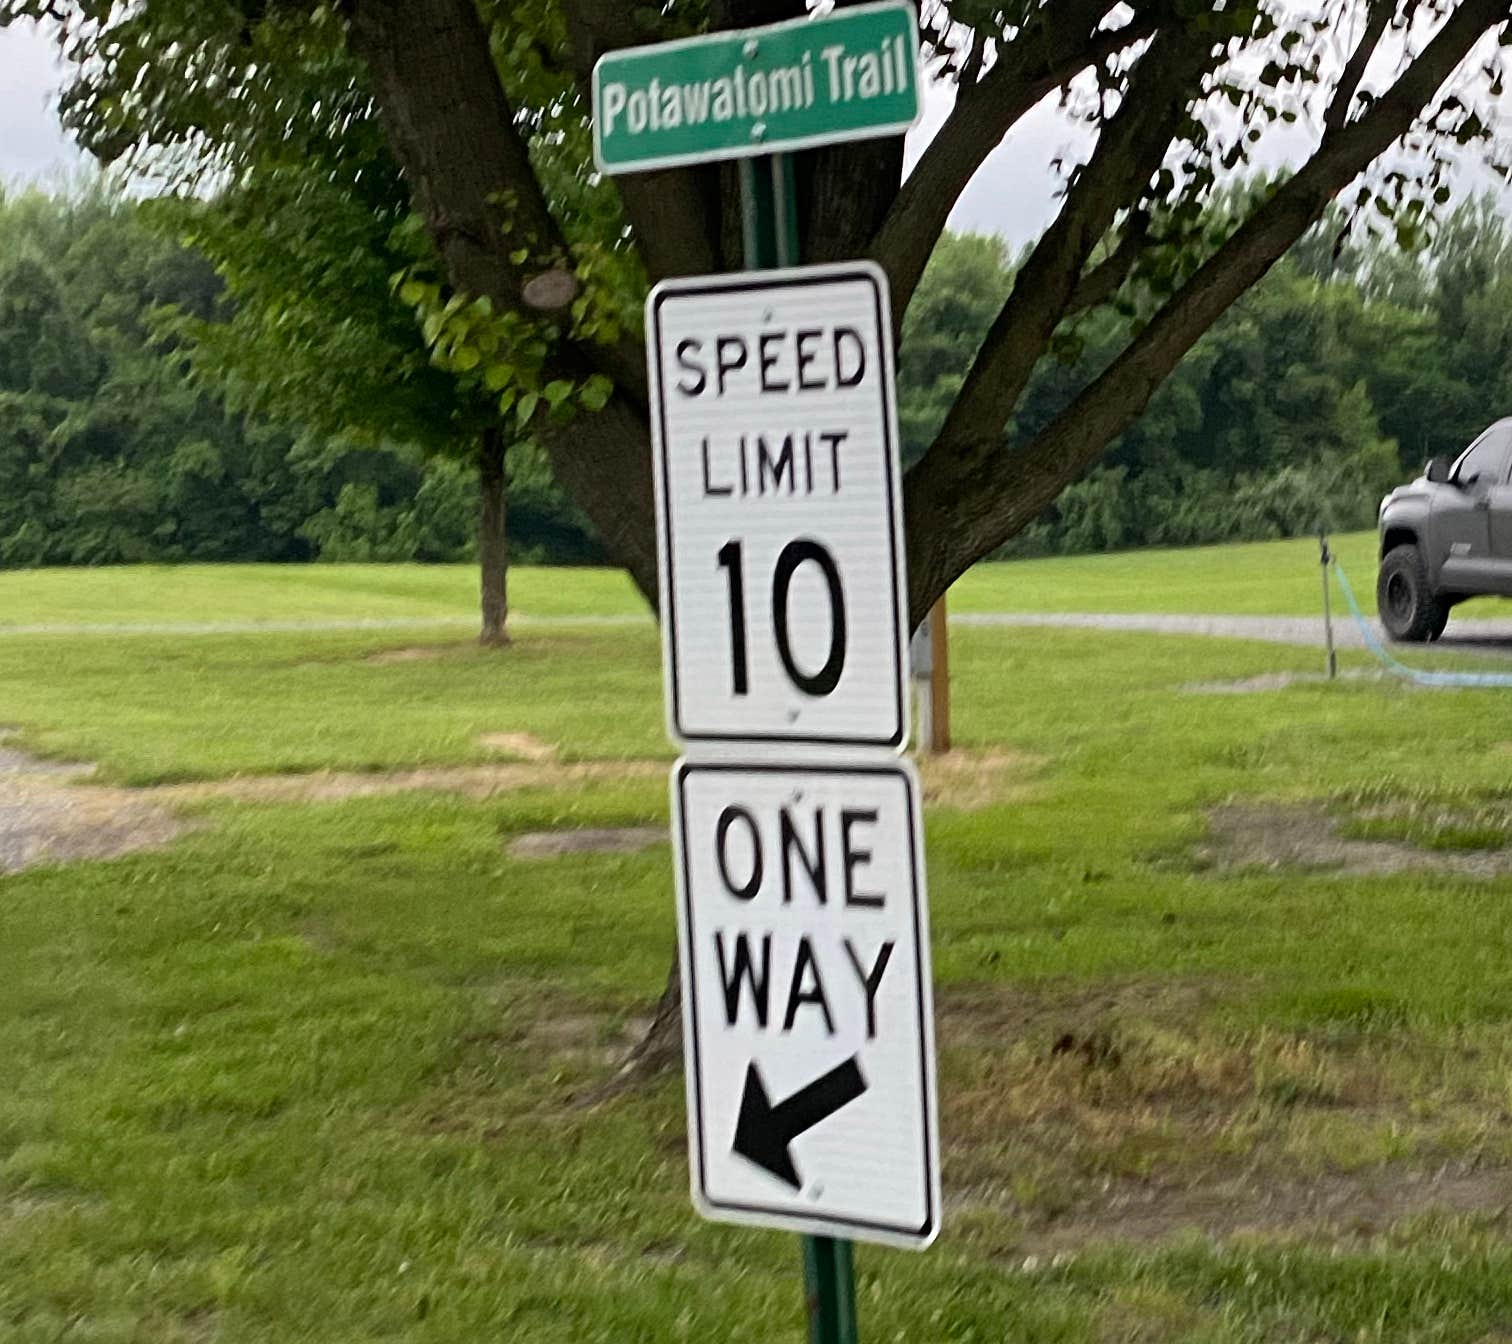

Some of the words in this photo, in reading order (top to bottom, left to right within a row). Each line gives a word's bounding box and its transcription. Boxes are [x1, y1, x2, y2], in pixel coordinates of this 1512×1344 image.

[602, 50, 815, 138] Potawatomi
[822, 33, 908, 105] Trail
[676, 327, 866, 397] SPEED
[702, 431, 848, 499] LIMIT
[717, 539, 847, 698] 10
[716, 804, 887, 908] ONE
[714, 931, 895, 1040] WAY
